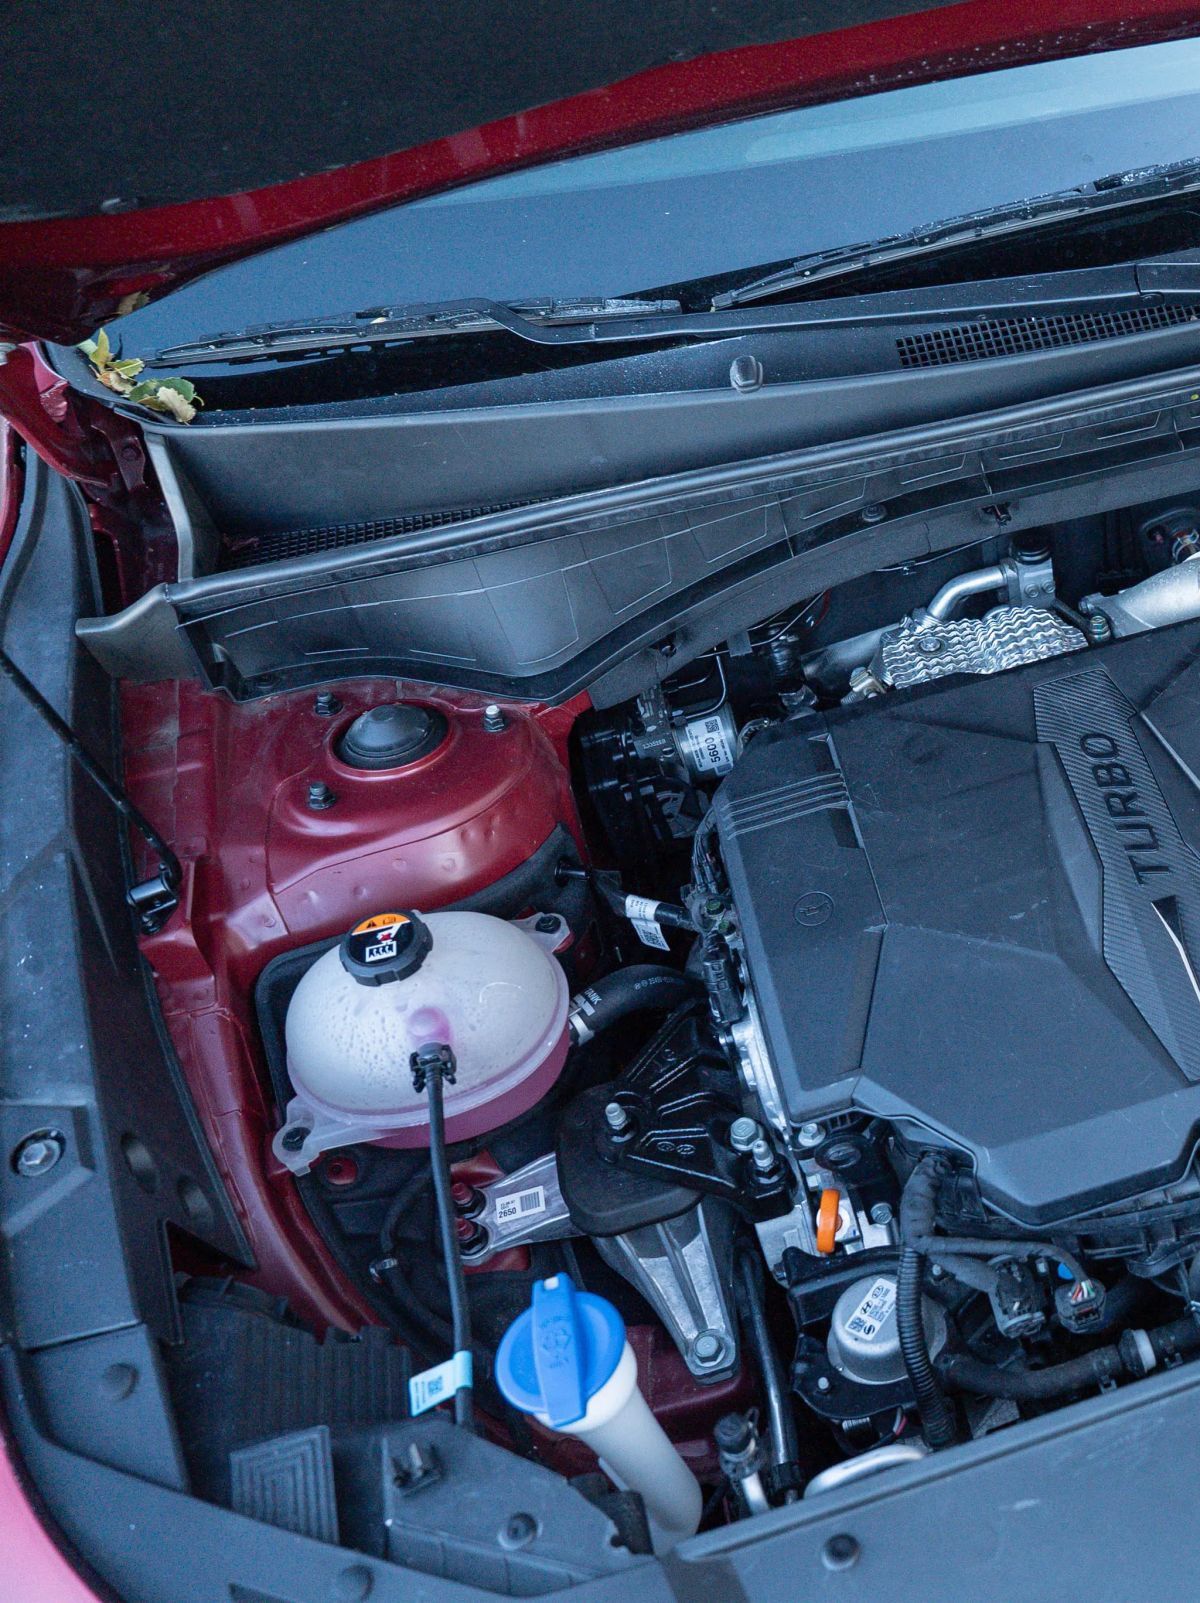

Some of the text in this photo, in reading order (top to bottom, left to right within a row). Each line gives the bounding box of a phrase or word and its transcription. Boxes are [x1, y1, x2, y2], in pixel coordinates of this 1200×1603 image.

[704, 736, 721, 764] 5600
[1079, 732, 1172, 887] TURBO
[498, 1206, 517, 1219] 2650
